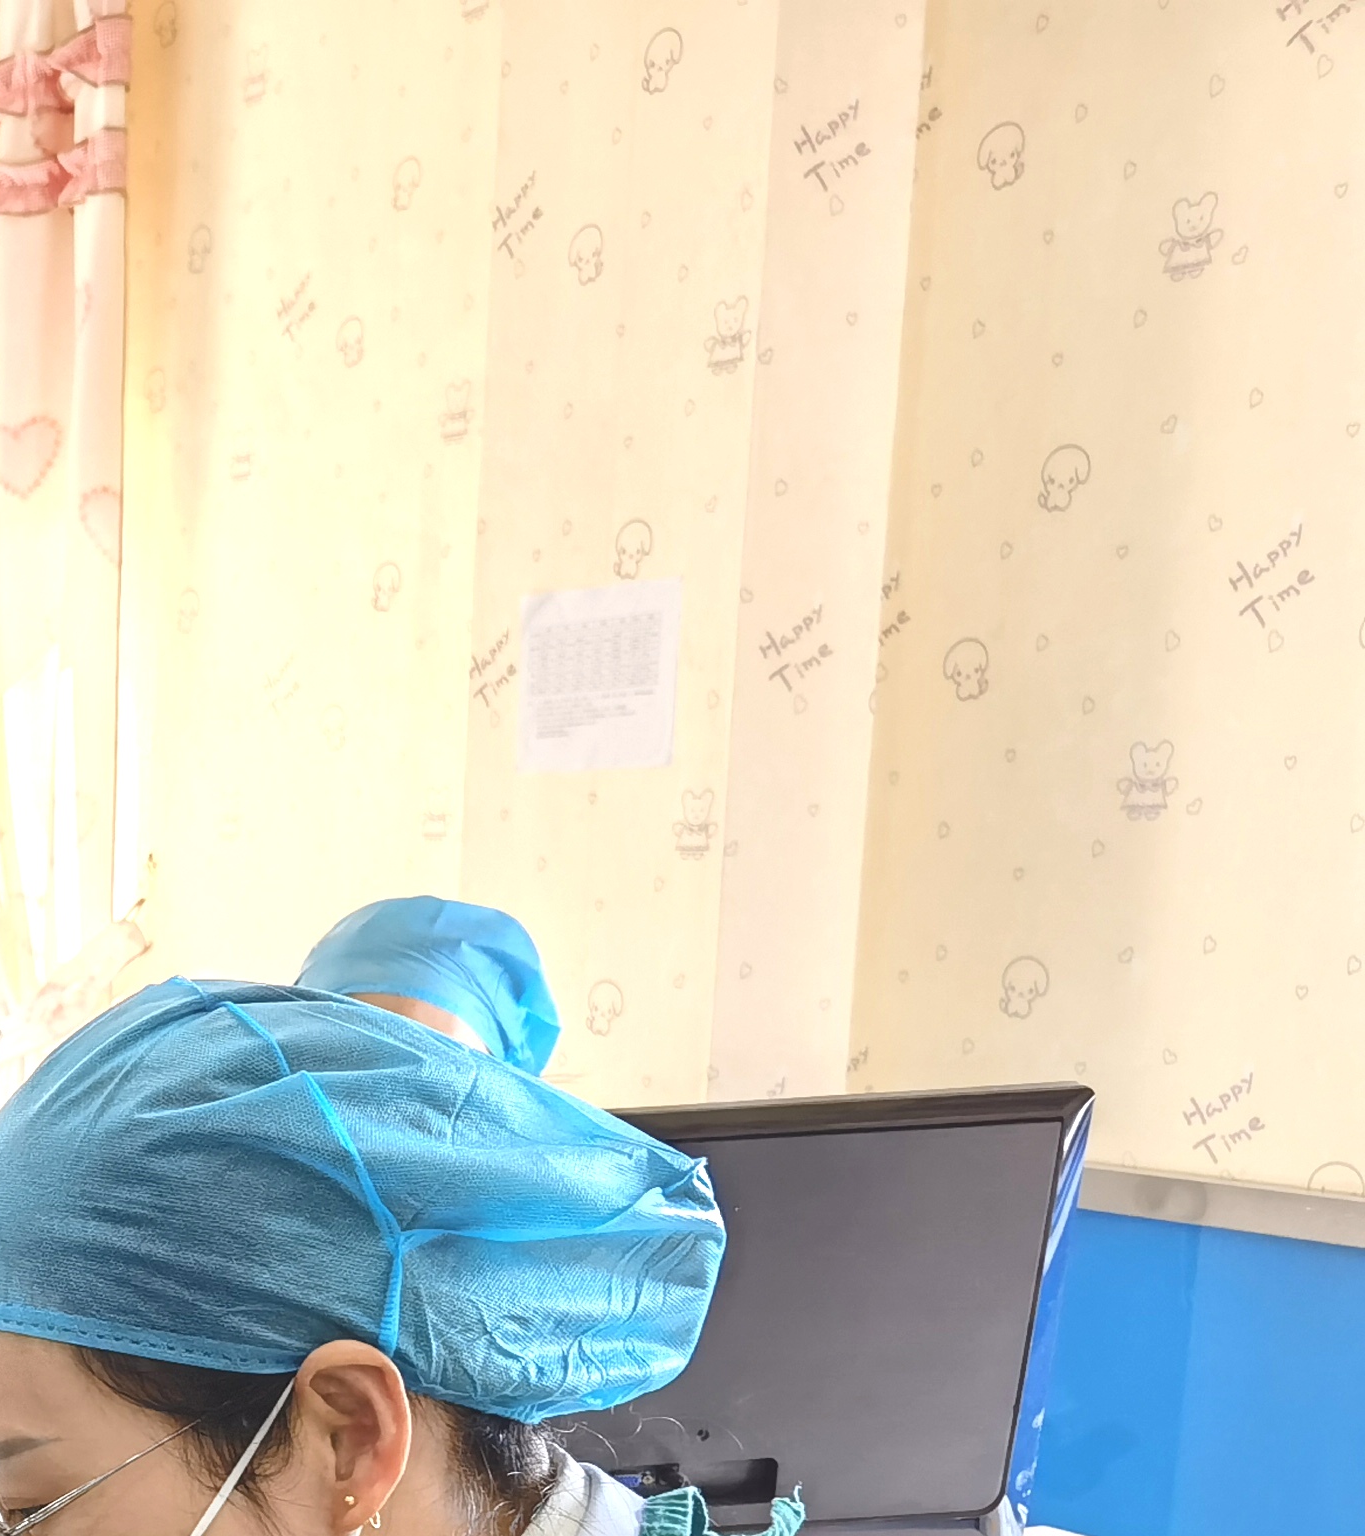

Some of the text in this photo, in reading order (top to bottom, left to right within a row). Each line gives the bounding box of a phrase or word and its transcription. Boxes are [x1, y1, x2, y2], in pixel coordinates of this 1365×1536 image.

[1286, 2, 1351, 55] Tim
[793, 99, 859, 155] Happy
[803, 142, 871, 192] Time
[492, 169, 536, 232] Happy
[497, 206, 543, 259] Time
[1228, 523, 1302, 592] Happy
[1239, 569, 1315, 629] Time
[469, 626, 509, 680] Happy
[758, 604, 822, 659] Happy
[473, 663, 517, 708] Time
[769, 643, 833, 692] Time
[1182, 1072, 1253, 1126] Happy
[1192, 1116, 1265, 1164] Time
